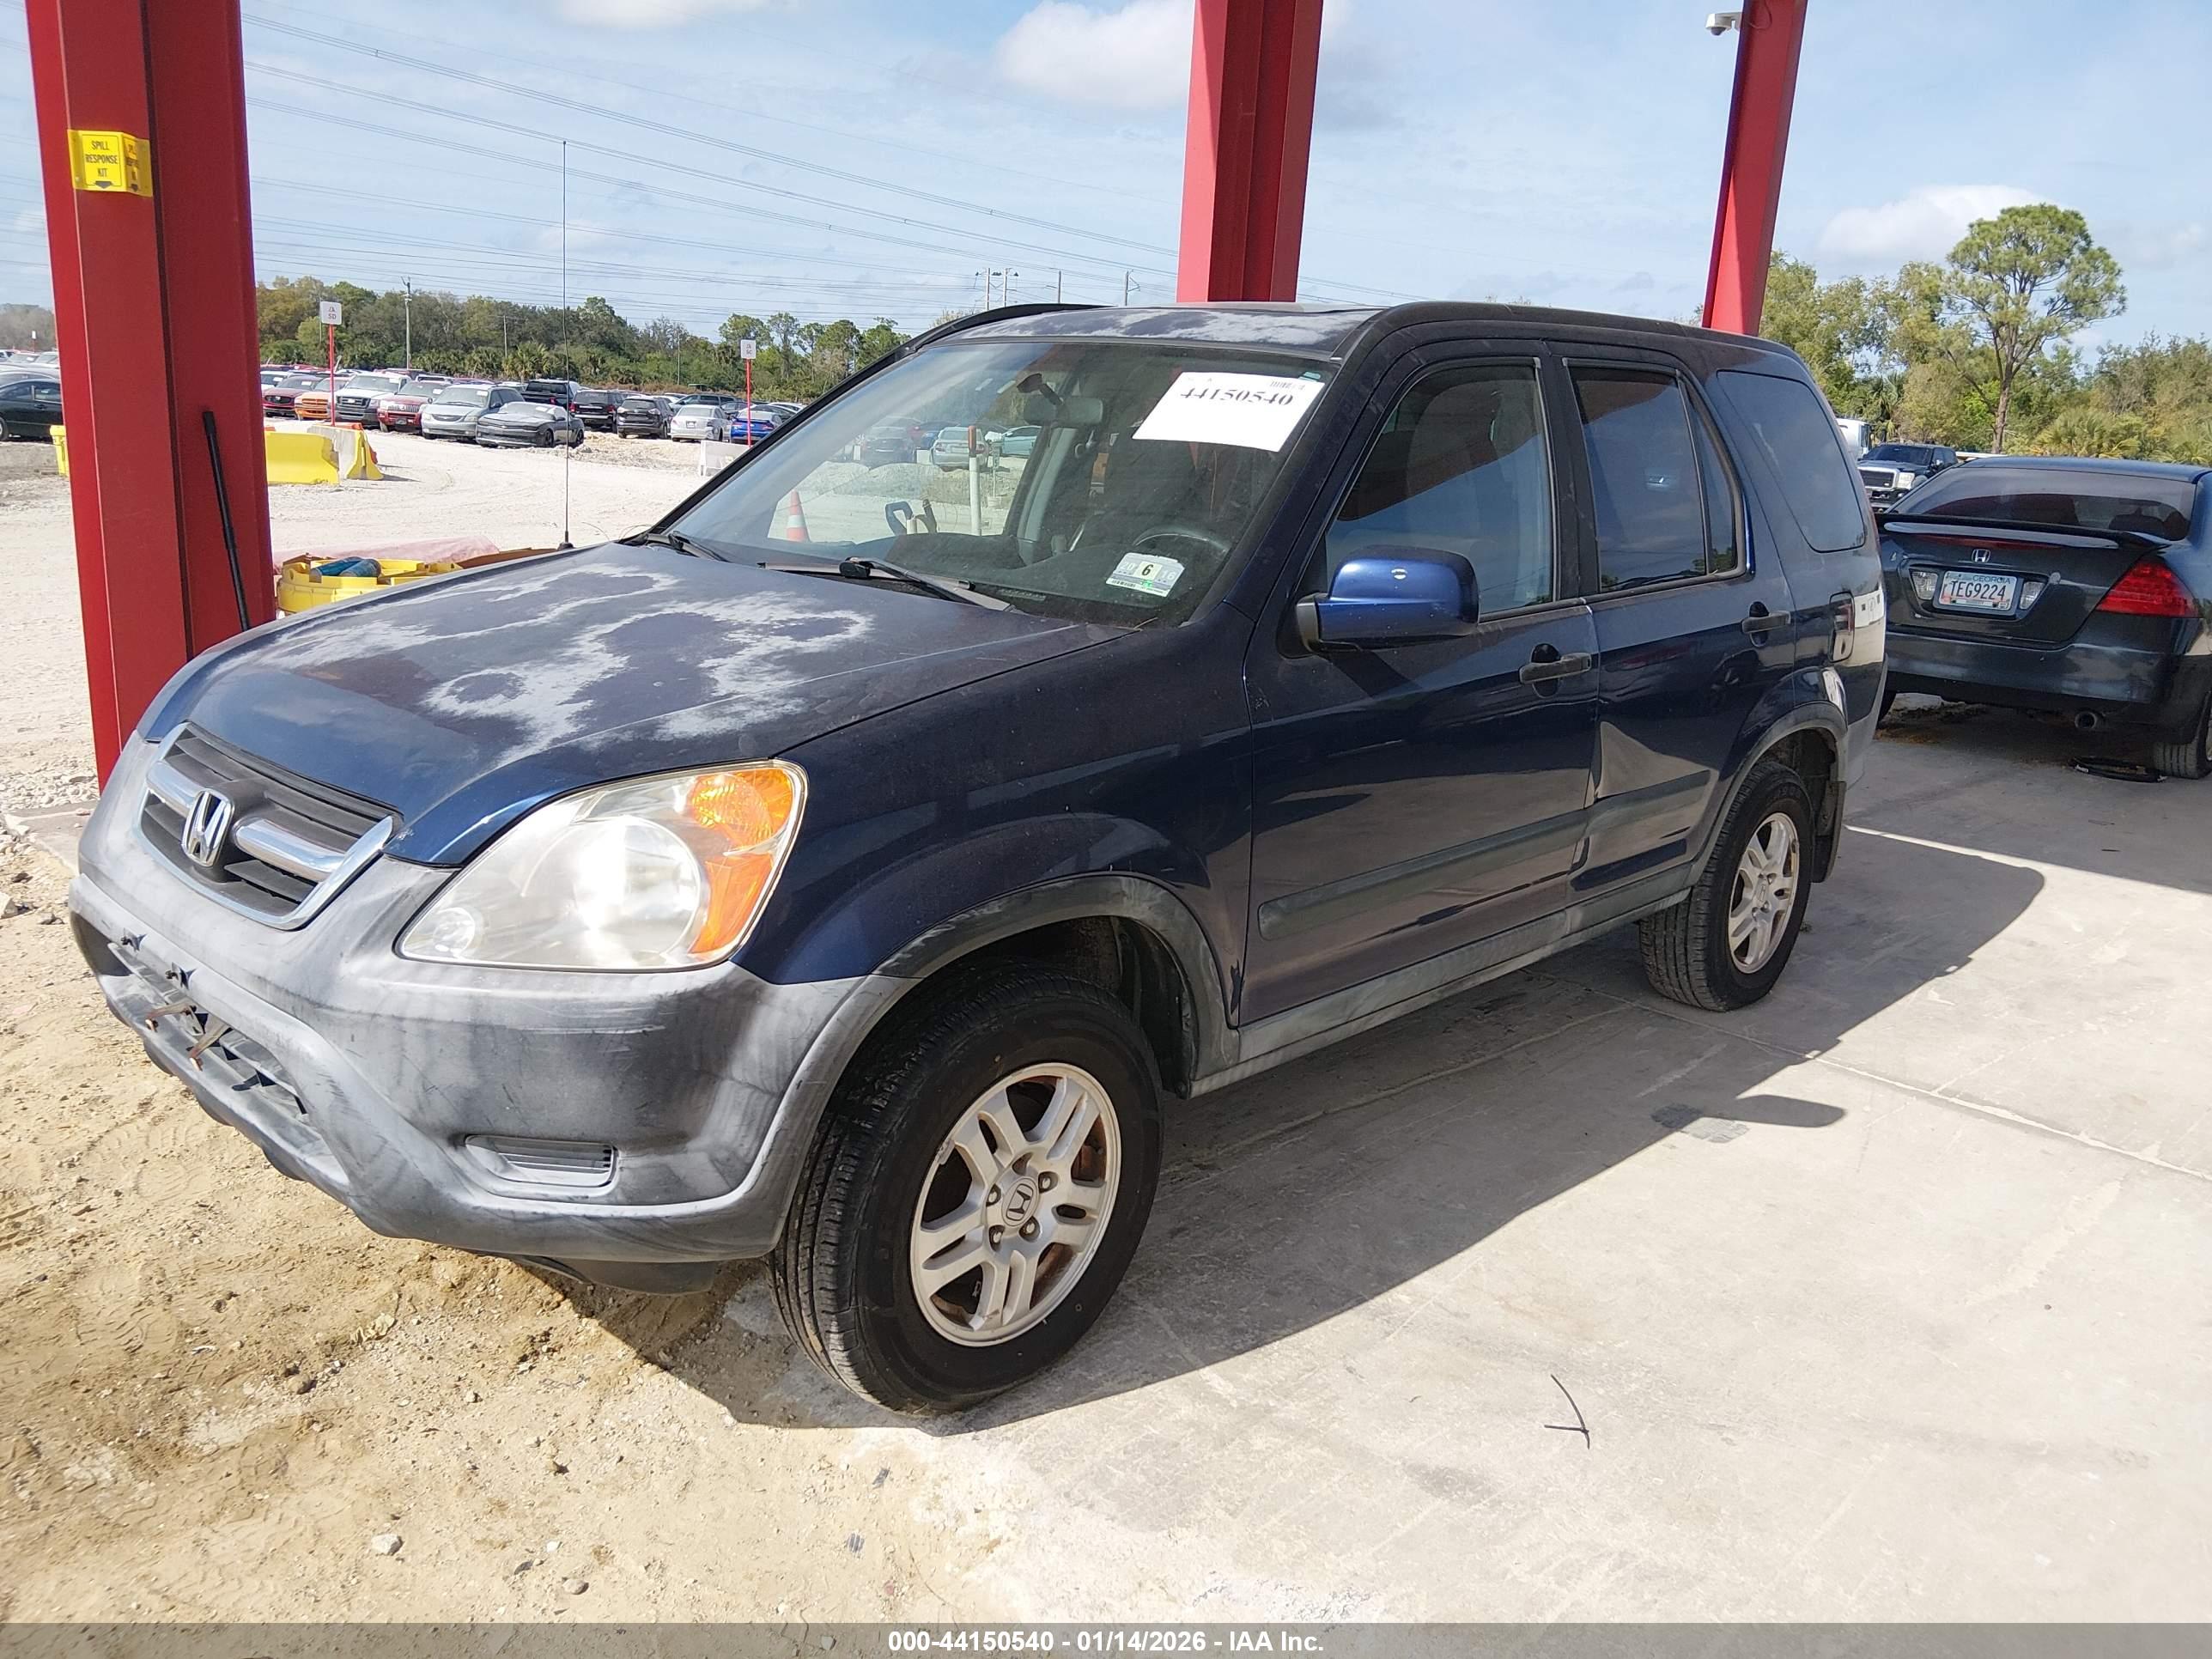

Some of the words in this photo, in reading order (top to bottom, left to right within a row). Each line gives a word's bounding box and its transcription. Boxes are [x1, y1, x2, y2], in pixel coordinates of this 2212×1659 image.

[90, 140, 110, 150] SPILL
[85, 154, 118, 165] RESPONSE
[97, 167, 107, 177] KIT
[1179, 387, 1294, 406] 44150540
[1141, 563, 1154, 576] 6
[1972, 574, 2011, 585] GEORGIA
[1949, 580, 2008, 601] TEG9224
